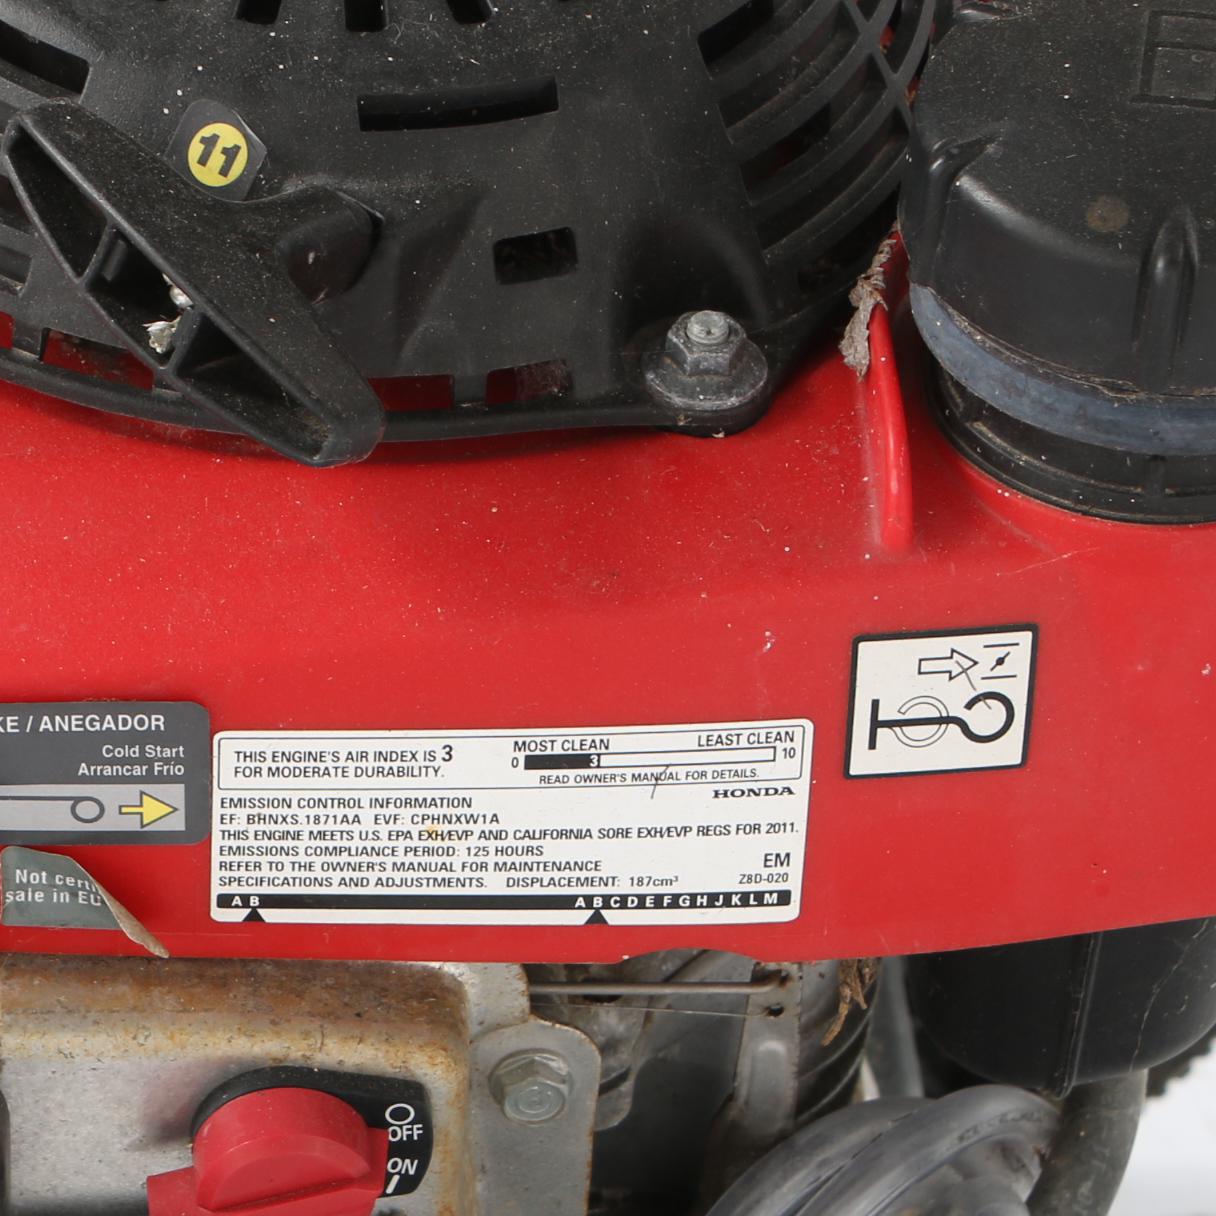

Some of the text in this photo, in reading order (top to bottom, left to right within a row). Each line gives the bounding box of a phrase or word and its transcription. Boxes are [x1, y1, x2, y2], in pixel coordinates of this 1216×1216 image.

[197, 133, 242, 179] 11
[26, 716, 33, 732] /
[39, 715, 164, 731] ANEGADOR
[514, 739, 609, 752] MOST CLEAN
[698, 731, 794, 747] LEAST CLEAN
[103, 745, 184, 759] Cold Start
[235, 745, 452, 763] THIS ENGINE'S AIR INDEX IS 3
[783, 747, 796, 759] 10
[511, 758, 519, 769] 0
[588, 755, 599, 768] 3
[78, 762, 184, 775] Arrancar Frío
[235, 766, 445, 778] FOR MODERATE DURABILITY.
[539, 768, 760, 784] READ OWNER'S MANUAL FOR DETAILS.
[714, 787, 794, 798] HONDA
[221, 797, 472, 808] EMISSION CONTROL INFORMATION
[220, 813, 499, 825] EF: BHNXS.1871AA EVF: CPHNXW1A
[220, 822, 799, 841] THIS ENGINE MEETS U.S. EPA EXH/EVP AND CALIFORNIA SORE EXH/EVP REGS FOR 2011.
[220, 846, 543, 856] EMISSIONS COMPLIANCE PERIOD: 125 HOURS
[219, 861, 601, 872] REFER TO THE OWNER'S MANUAL FOR MAINTENANCE
[764, 853, 790, 868] EM
[15, 869, 47, 885] Not
[219, 876, 332, 887] SPECIFICATIONS
[338, 877, 369, 887] AND
[375, 877, 487, 887] ADJUSTMENTS.
[507, 876, 620, 887] DISPLACEMENT:
[739, 873, 788, 884] Z8D-020
[5, 888, 45, 903] sale
[52, 888, 70, 903] in
[232, 896, 259, 906] A B
[575, 893, 777, 907] A B C D E F G H J K L M
[388, 1124, 424, 1142] OFF
[386, 1157, 419, 1176] ON
